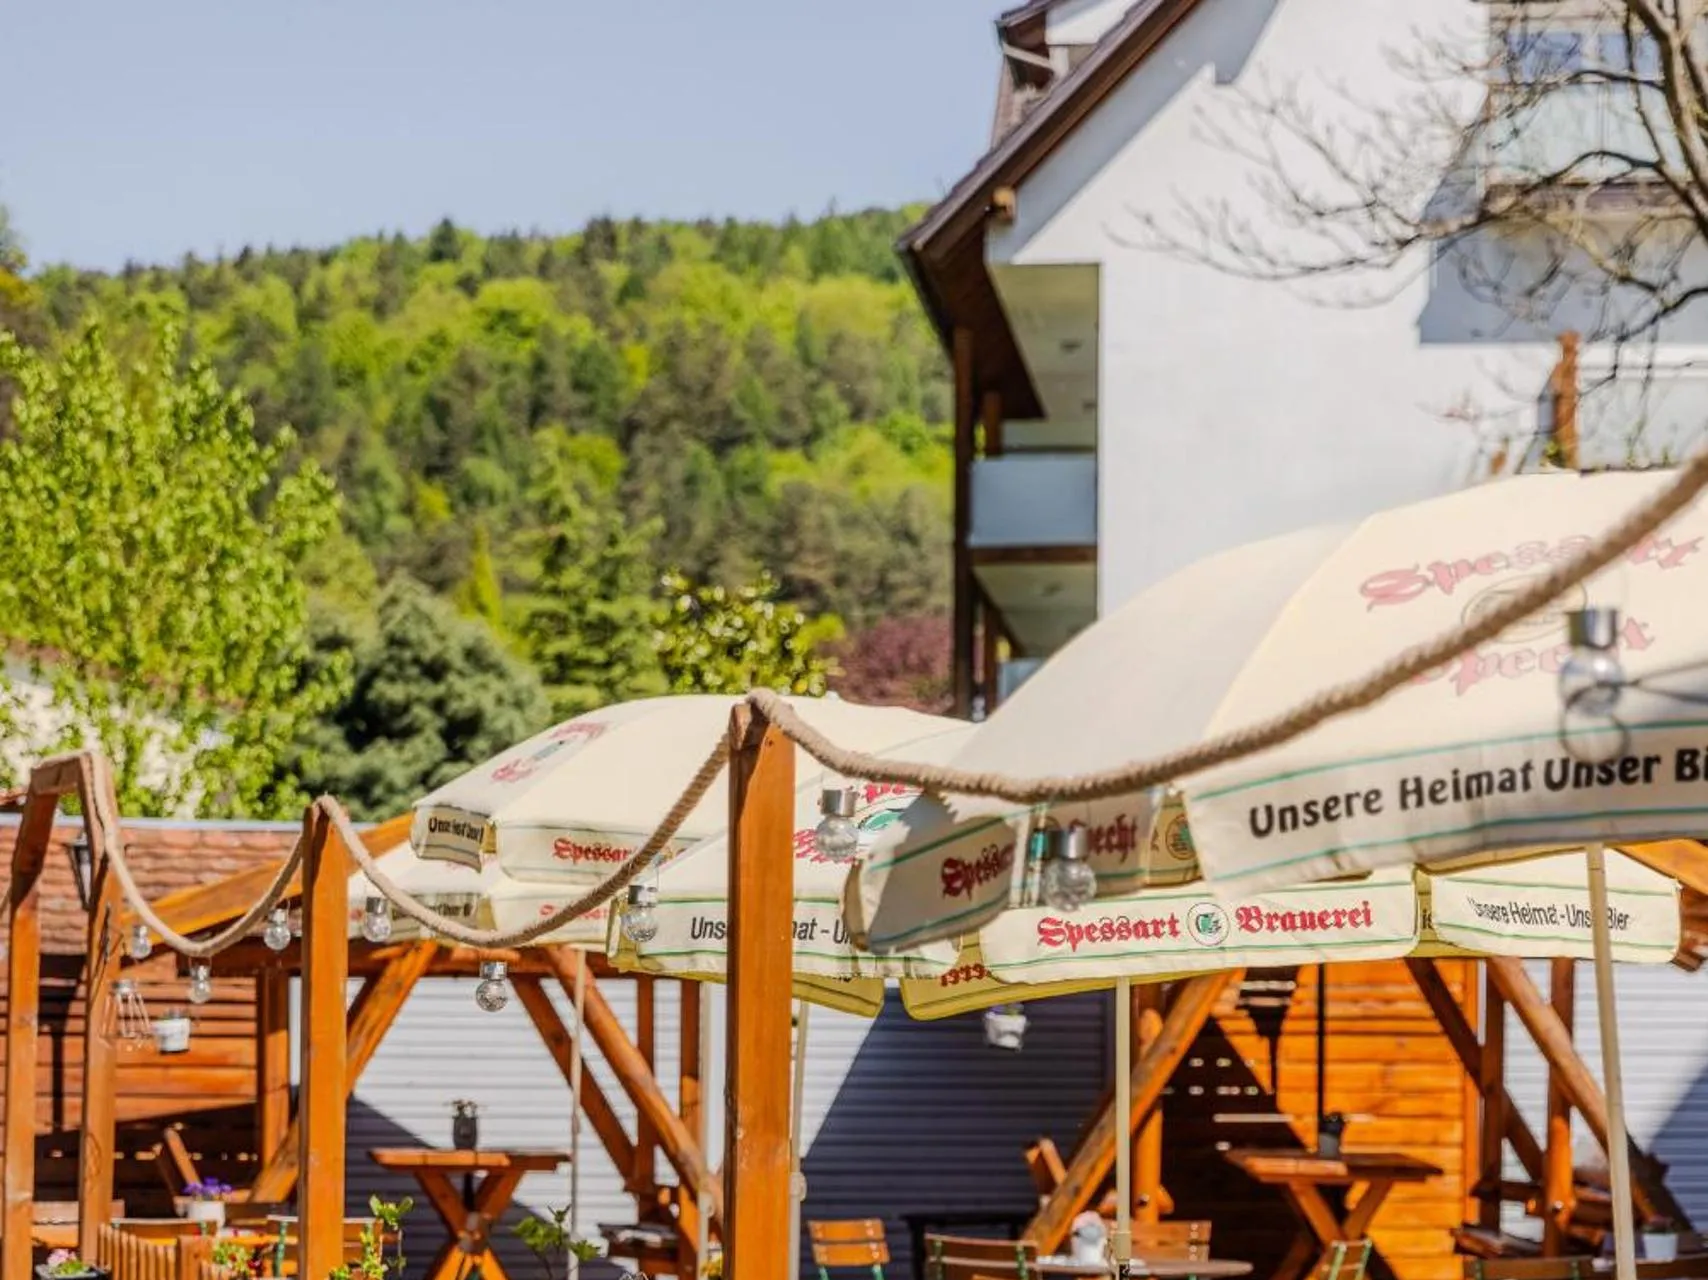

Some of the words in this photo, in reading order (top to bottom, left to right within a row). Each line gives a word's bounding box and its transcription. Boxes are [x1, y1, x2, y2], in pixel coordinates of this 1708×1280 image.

[1359, 534, 1704, 613] Spessrt
[1249, 787, 1384, 839] Unsere
[1400, 759, 1538, 811] Heimat
[1543, 752, 1662, 792] Unser
[553, 837, 632, 866] Spessar
[1036, 911, 1182, 952] Spessart
[1235, 900, 1374, 934] Brauerei
